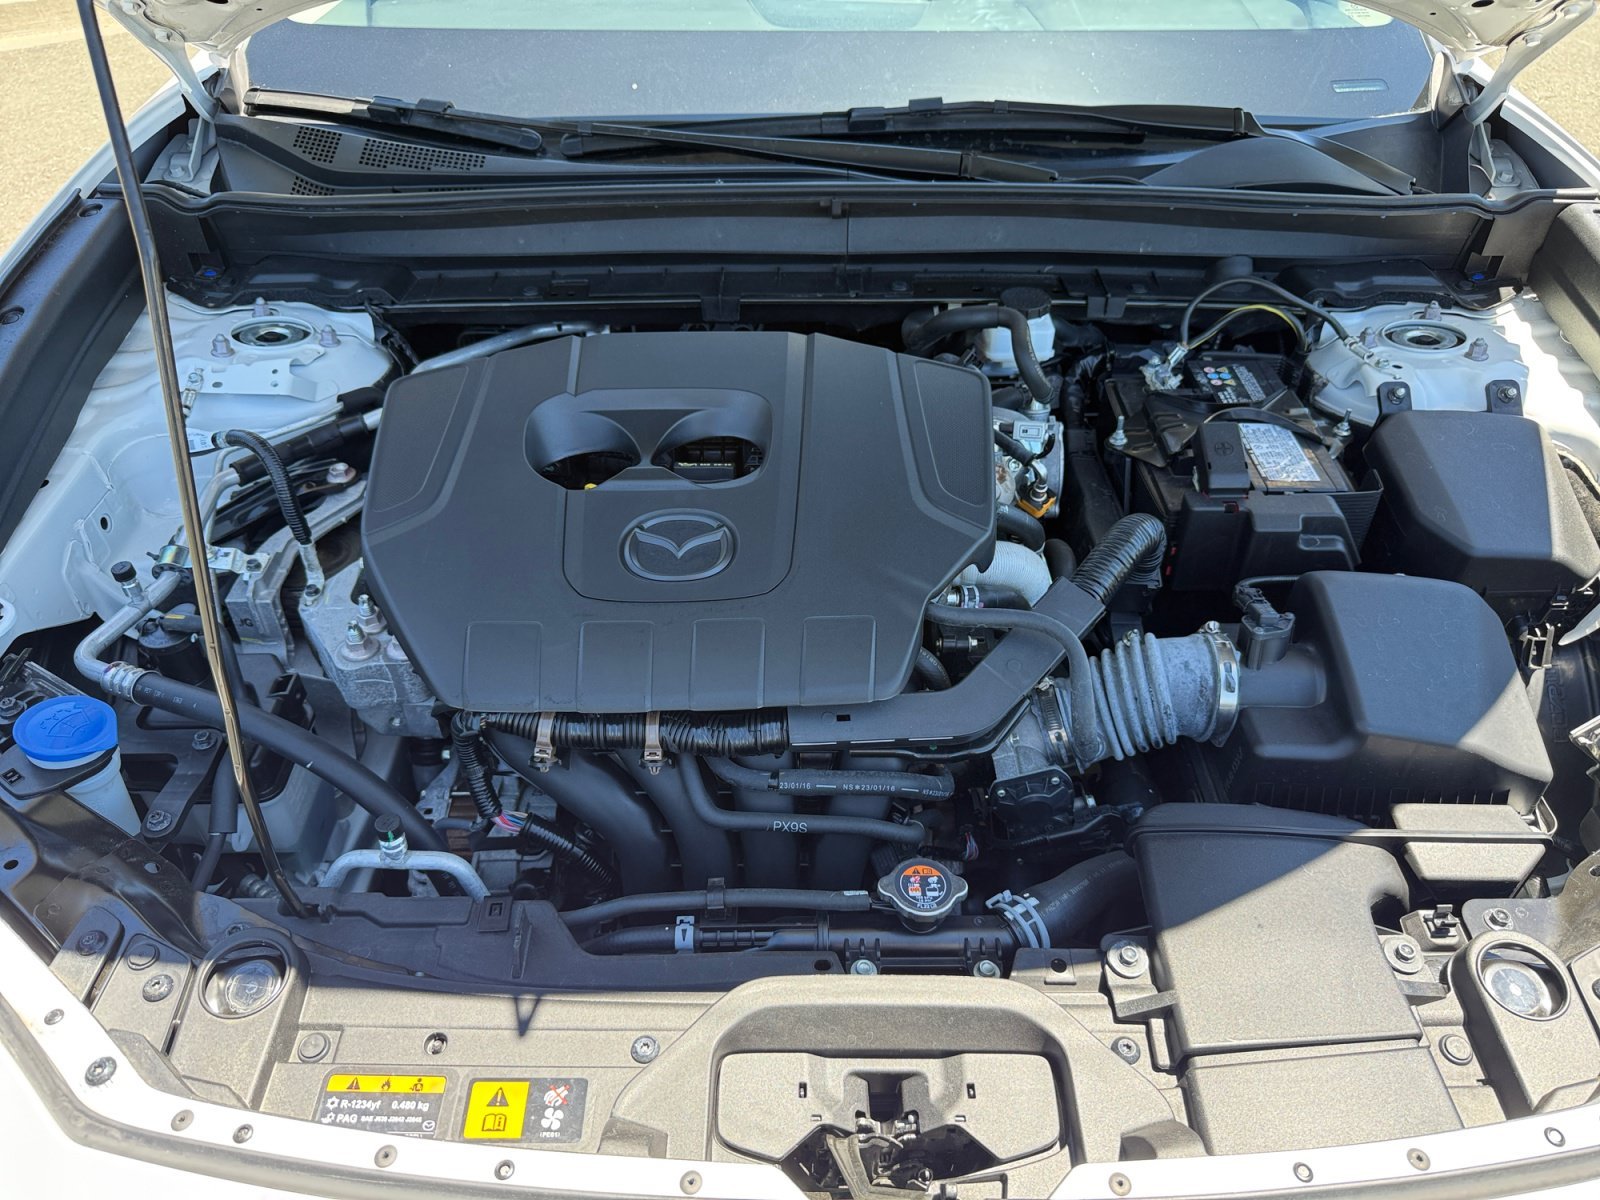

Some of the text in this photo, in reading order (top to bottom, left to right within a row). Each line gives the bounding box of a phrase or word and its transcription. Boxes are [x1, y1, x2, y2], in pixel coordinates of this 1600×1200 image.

[779, 782, 812, 790] 23/01/16
[773, 820, 808, 834] PX9S
[339, 1099, 430, 1112] R-1234yf 0.480 kg
[336, 1113, 358, 1124] PAG
